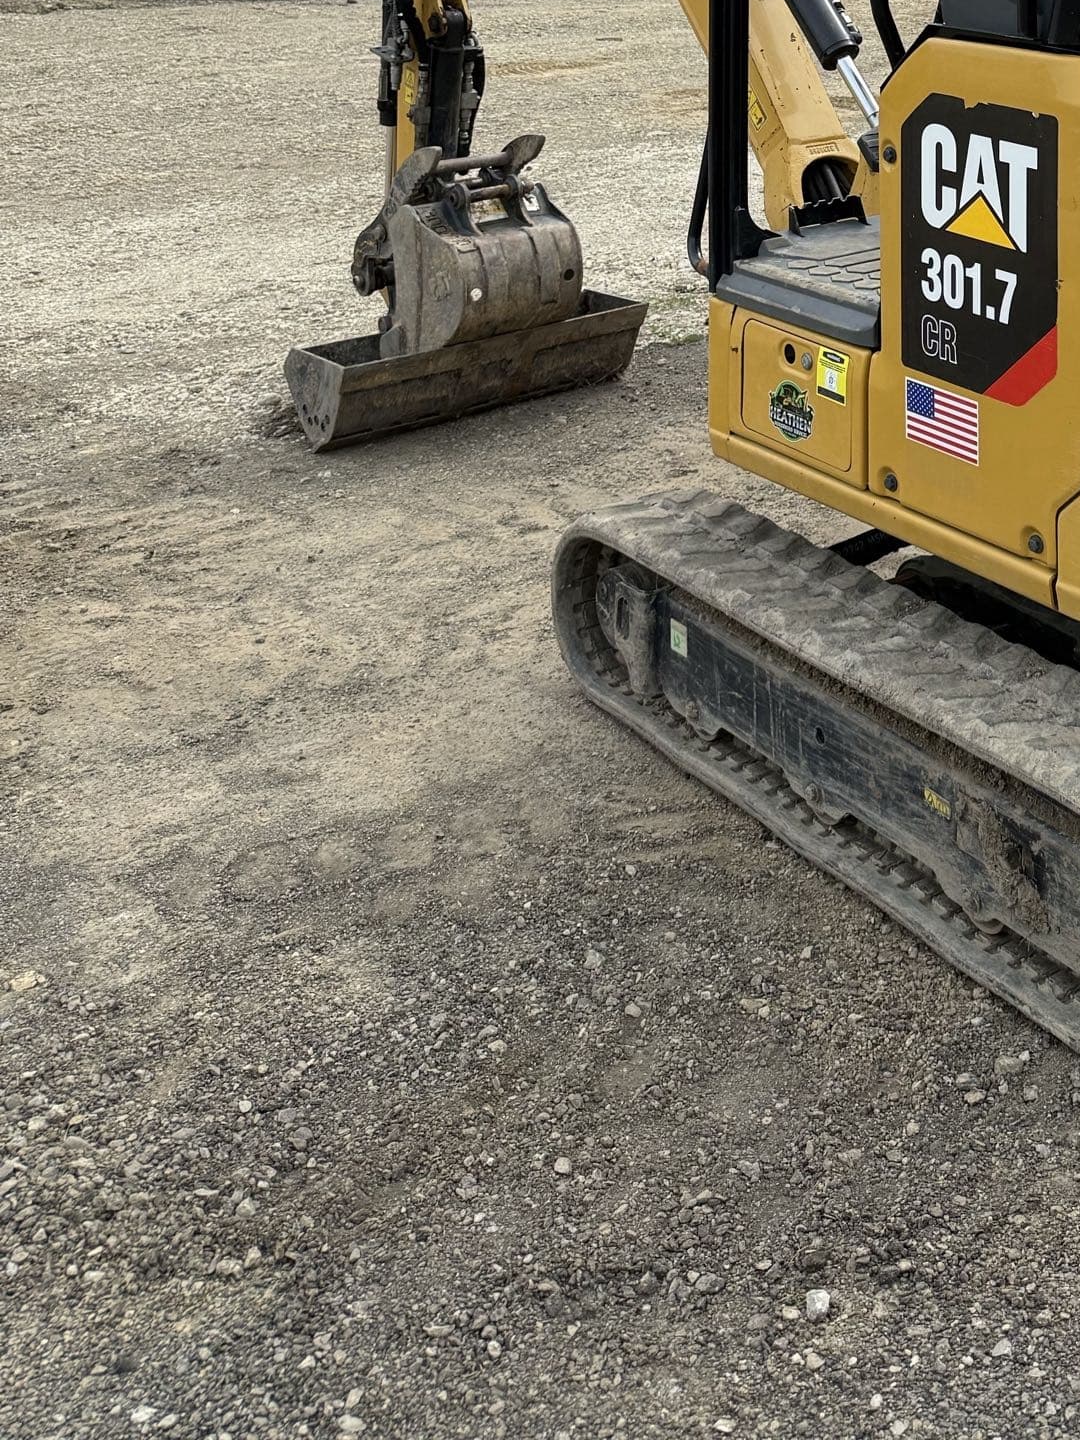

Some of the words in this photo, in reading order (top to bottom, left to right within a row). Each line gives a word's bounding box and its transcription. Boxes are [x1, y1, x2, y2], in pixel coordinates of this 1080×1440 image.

[921, 123, 1038, 253] CAT
[921, 247, 1018, 325] 301.7
[921, 314, 958, 364] CR
[770, 405, 812, 433] HEATHEN
